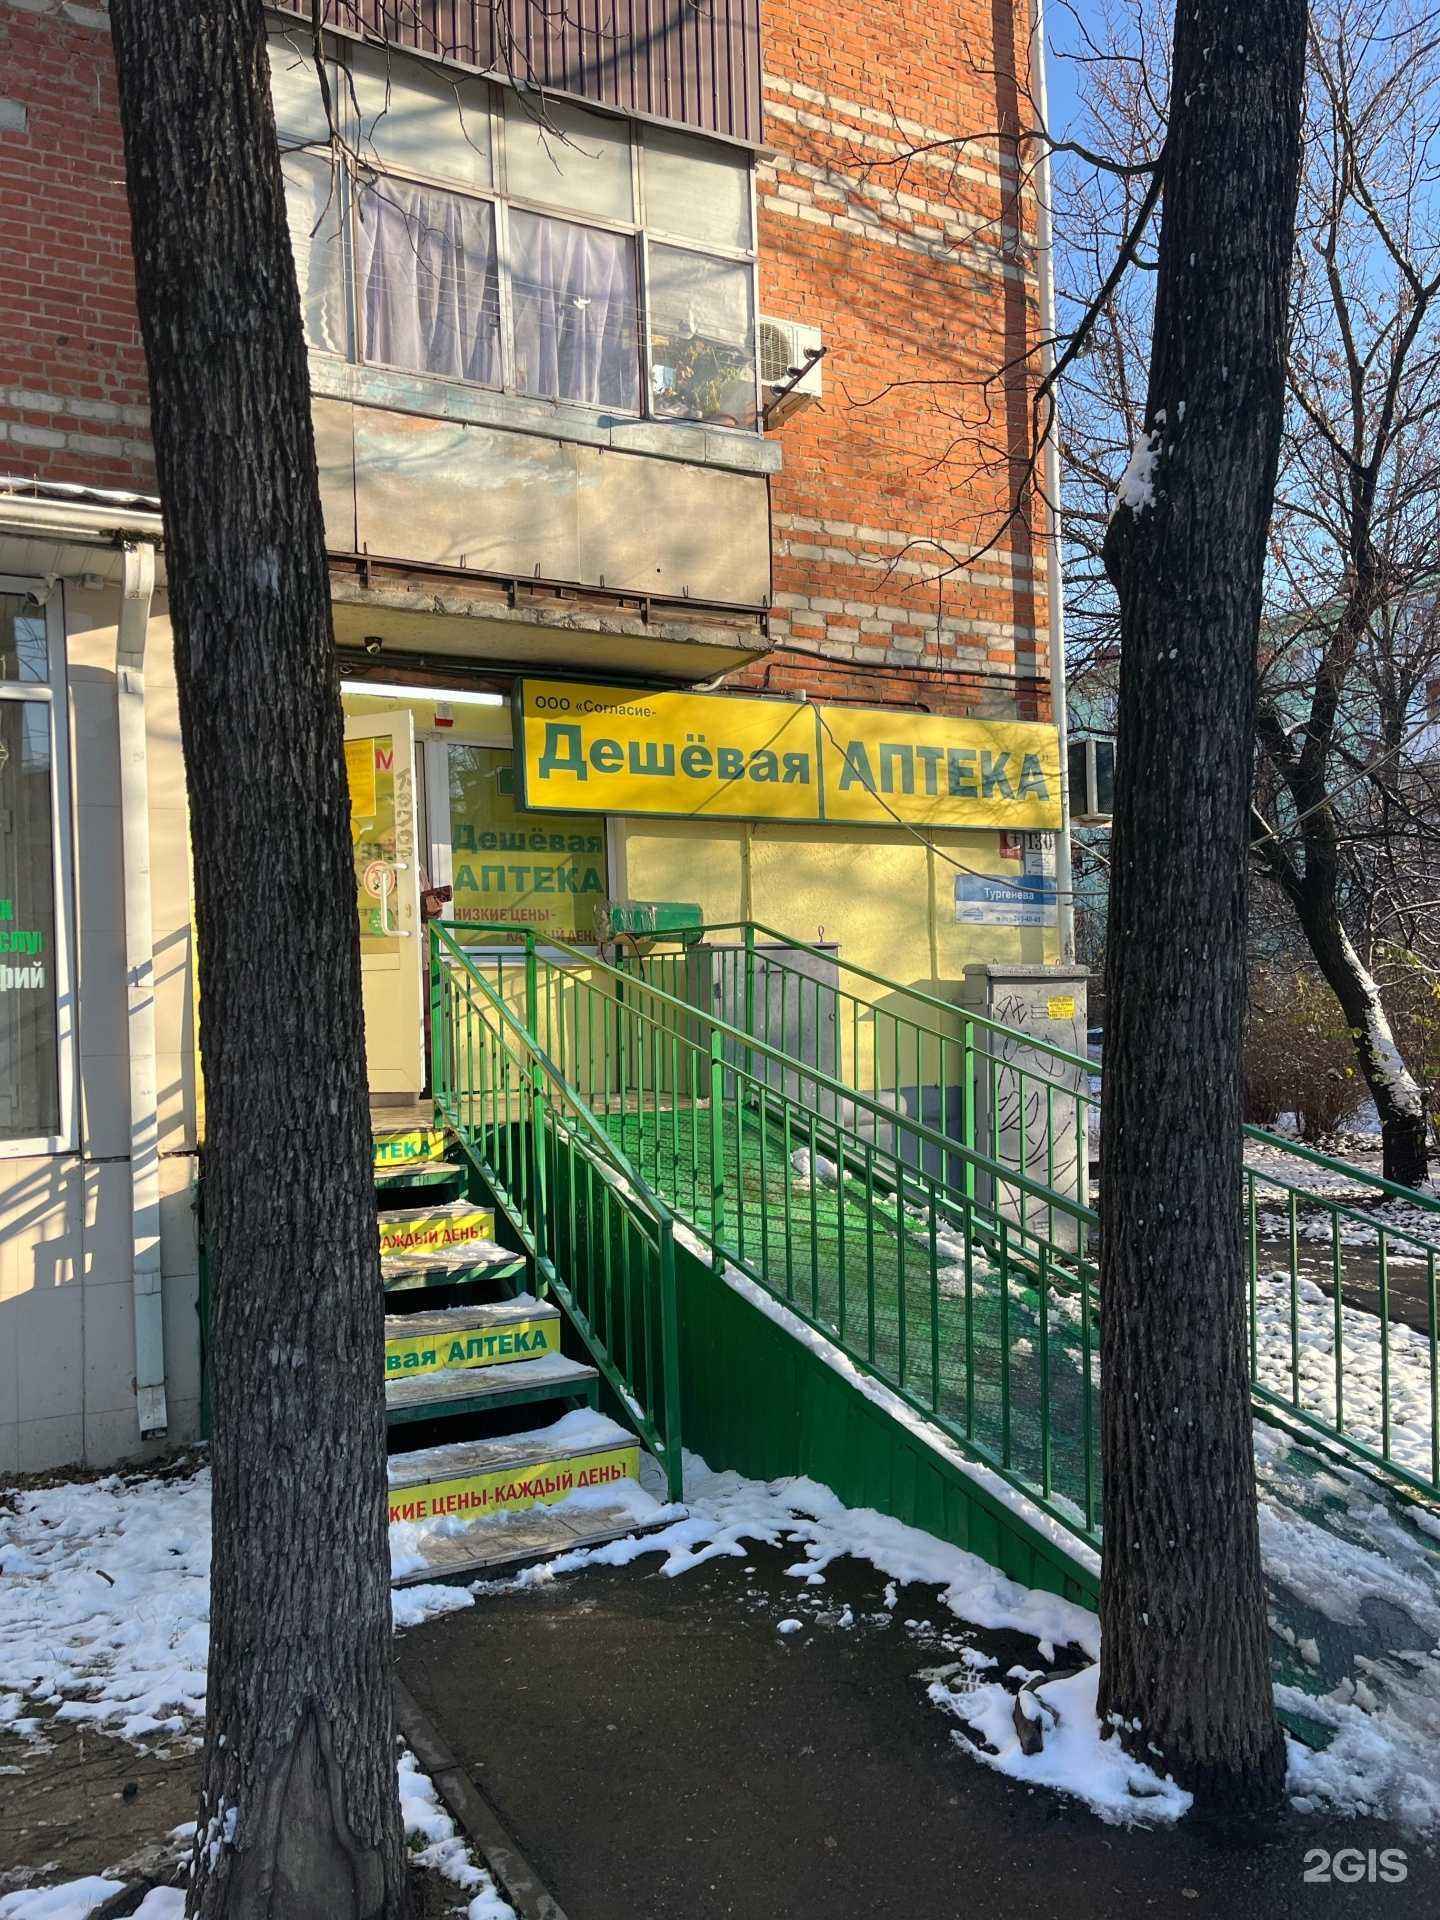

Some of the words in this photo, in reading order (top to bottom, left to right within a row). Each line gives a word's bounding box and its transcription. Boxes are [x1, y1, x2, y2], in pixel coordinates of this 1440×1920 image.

[535, 695, 570, 711] ООО
[538, 722, 811, 785] Дешёвая
[838, 740, 1050, 801] АПТЕКА
[452, 824, 601, 854] Дешёвая
[453, 864, 605, 894] АПТЕКА
[983, 887, 1034, 900] Тургенева
[454, 907, 508, 921] НИЗКИЕ
[381, 1227, 438, 1249] АЖДЫЙ
[442, 1225, 484, 1244] ДЕНЬ!
[386, 1350, 436, 1371] вая
[448, 1330, 548, 1362] АПТЕКА
[389, 1500, 427, 1522] КИЕ
[577, 1462, 627, 1488] ДЕНЬ!
